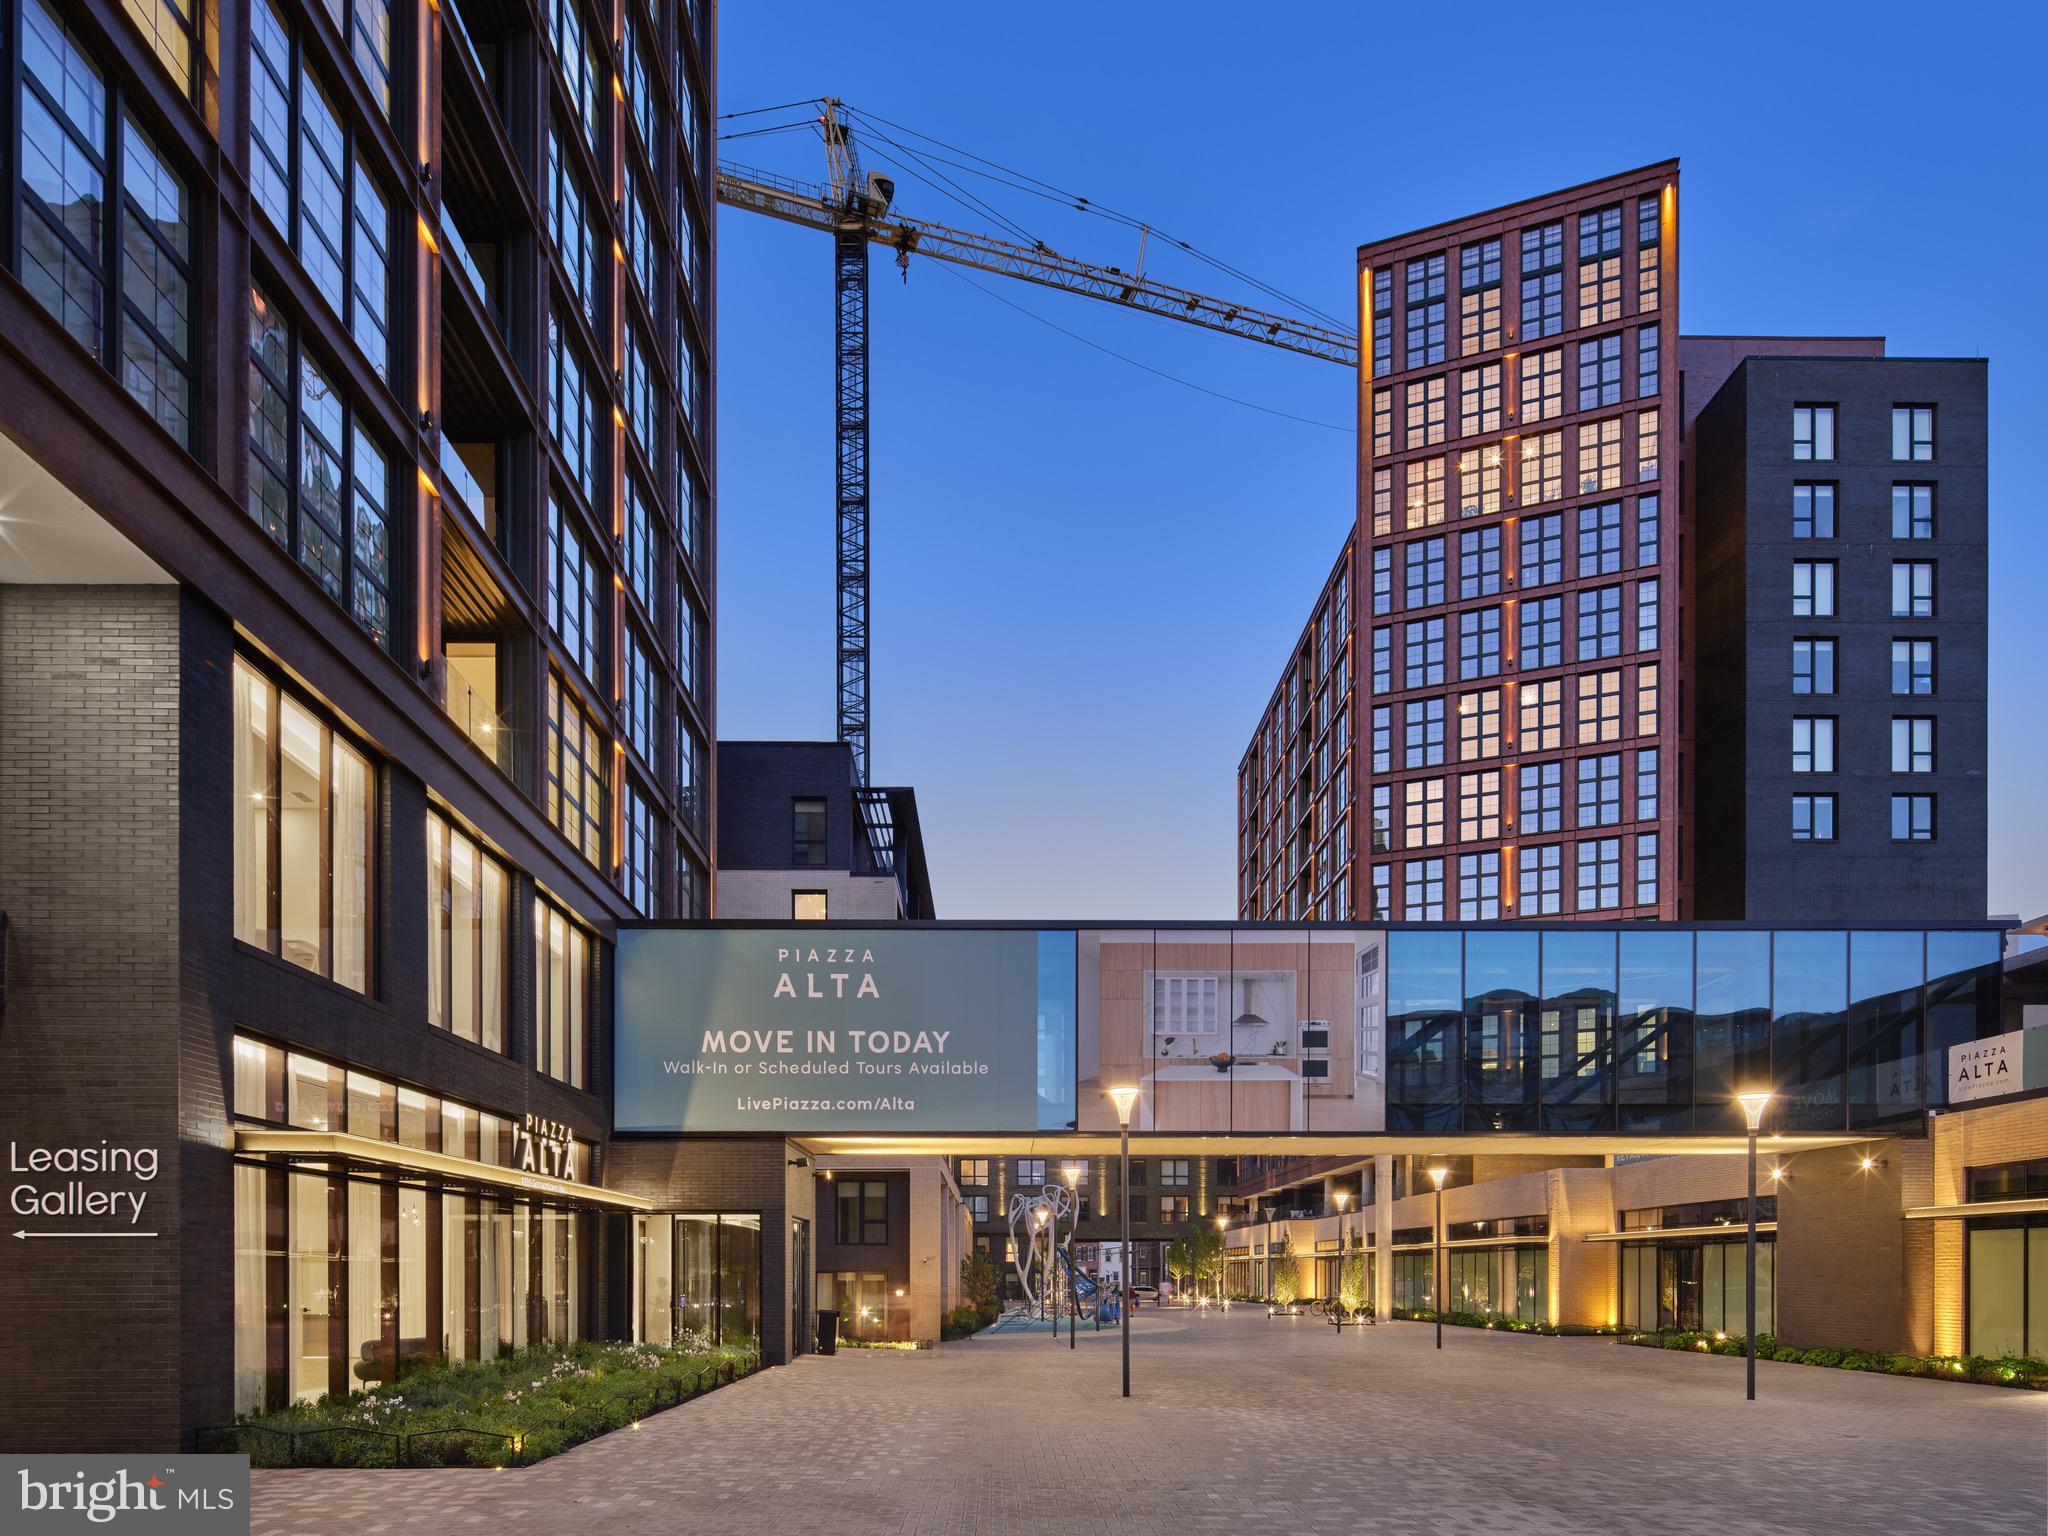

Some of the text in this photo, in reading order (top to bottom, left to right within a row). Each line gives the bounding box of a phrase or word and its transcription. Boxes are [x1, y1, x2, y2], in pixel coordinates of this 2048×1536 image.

[778, 948, 875, 963] PIAZZA
[773, 973, 880, 998] ALTA
[701, 1030, 951, 1054] MOVE IN TODAY
[1960, 1045, 2006, 1062] PIAZZA
[663, 1060, 989, 1075] Walk-In or Scheduled Tours Available
[1958, 1060, 2009, 1082] ALTA
[737, 1096, 915, 1112] LivePiazza.com/Alta
[526, 1113, 573, 1143] PIAZZA
[10, 1139, 159, 1181] Leasing
[522, 1138, 575, 1181] ALTA
[10, 1181, 147, 1224] Gallery
